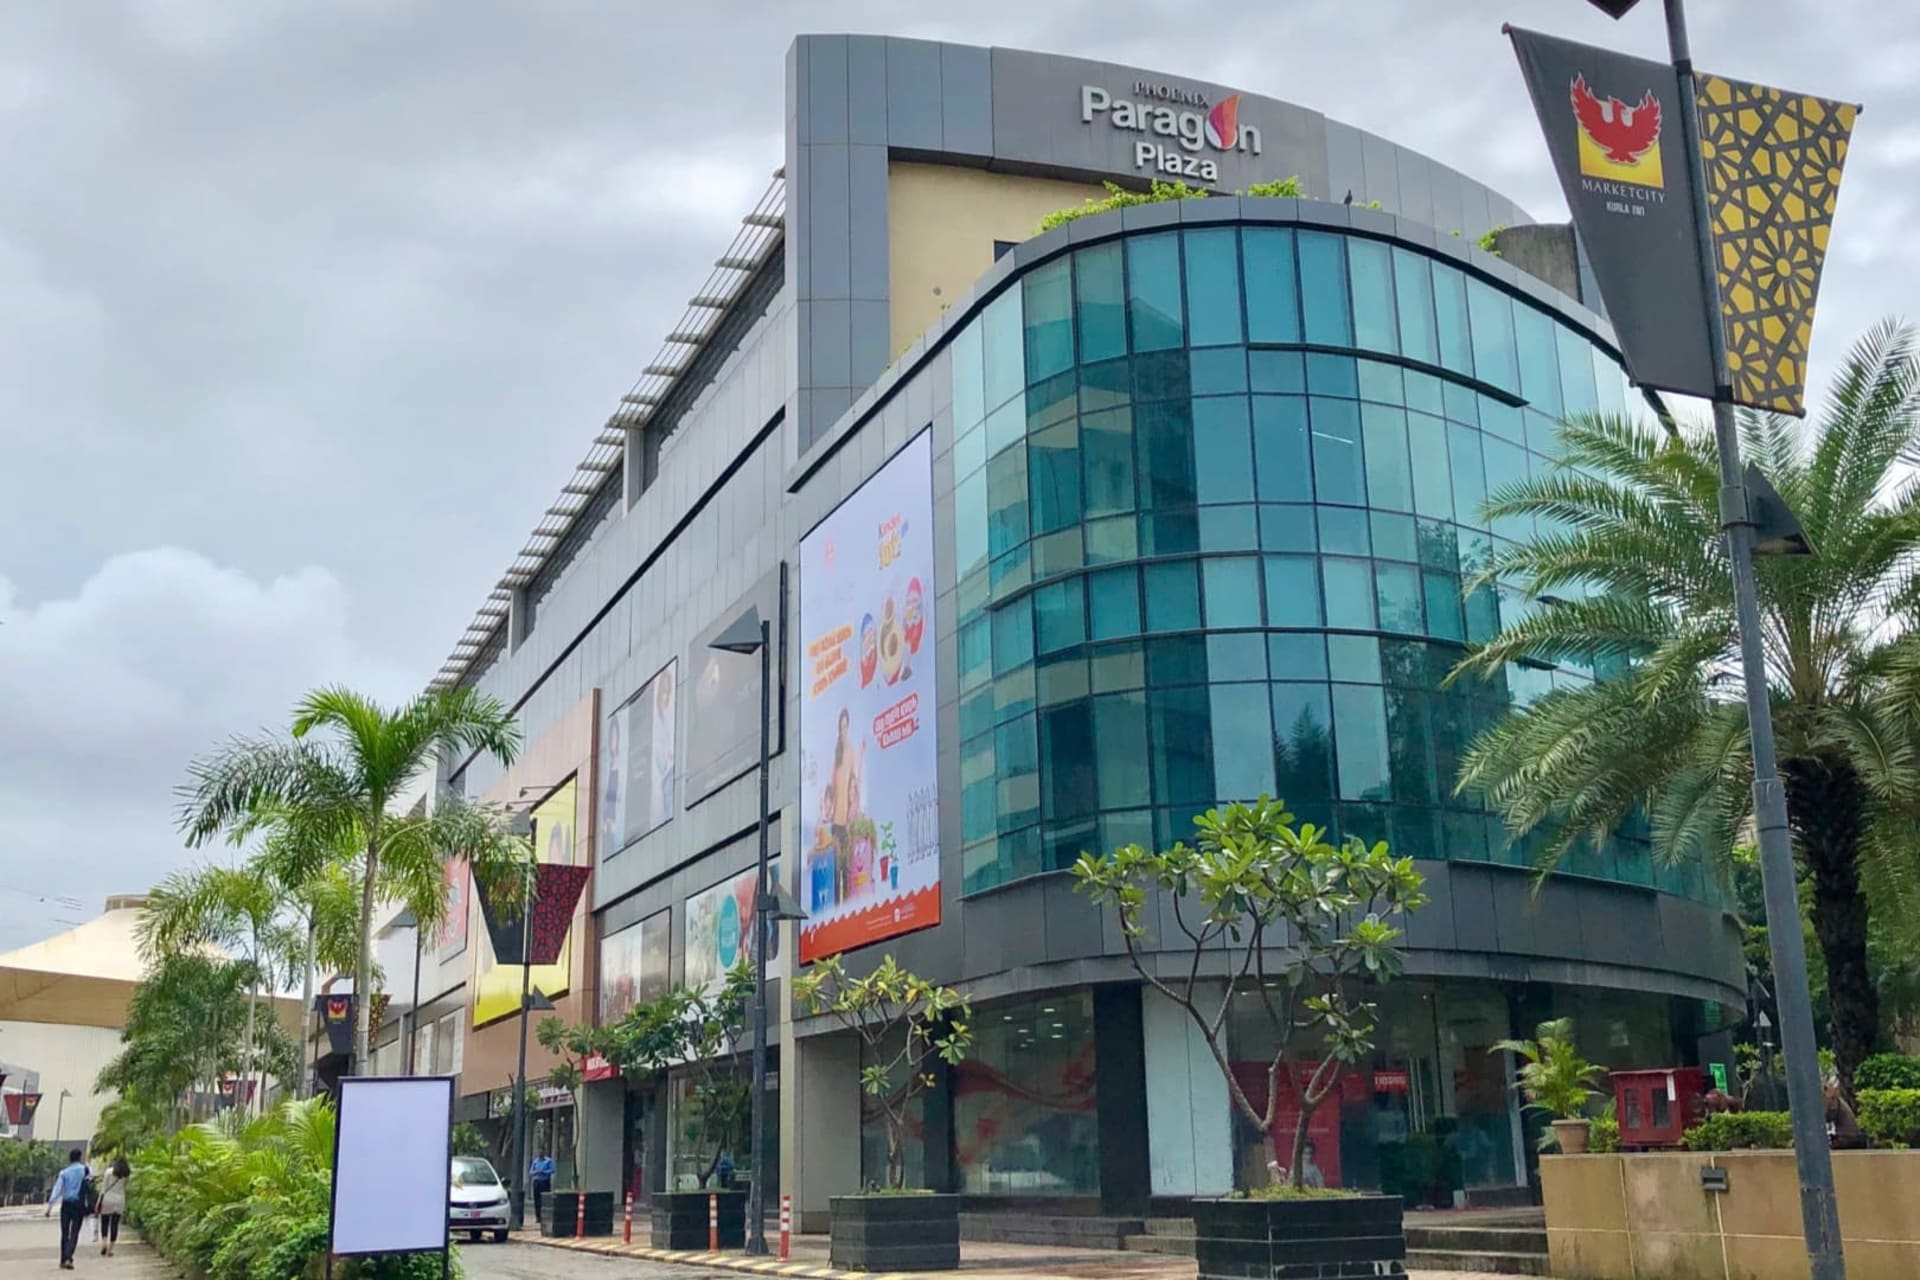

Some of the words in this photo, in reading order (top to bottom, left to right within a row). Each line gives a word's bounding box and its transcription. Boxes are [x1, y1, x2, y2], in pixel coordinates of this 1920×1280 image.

[1134, 81, 1209, 109] PHOENIX
[1081, 85, 1262, 155] Paragon
[1135, 142, 1217, 181] Plaza
[1582, 180, 1665, 203] MARKETCITY
